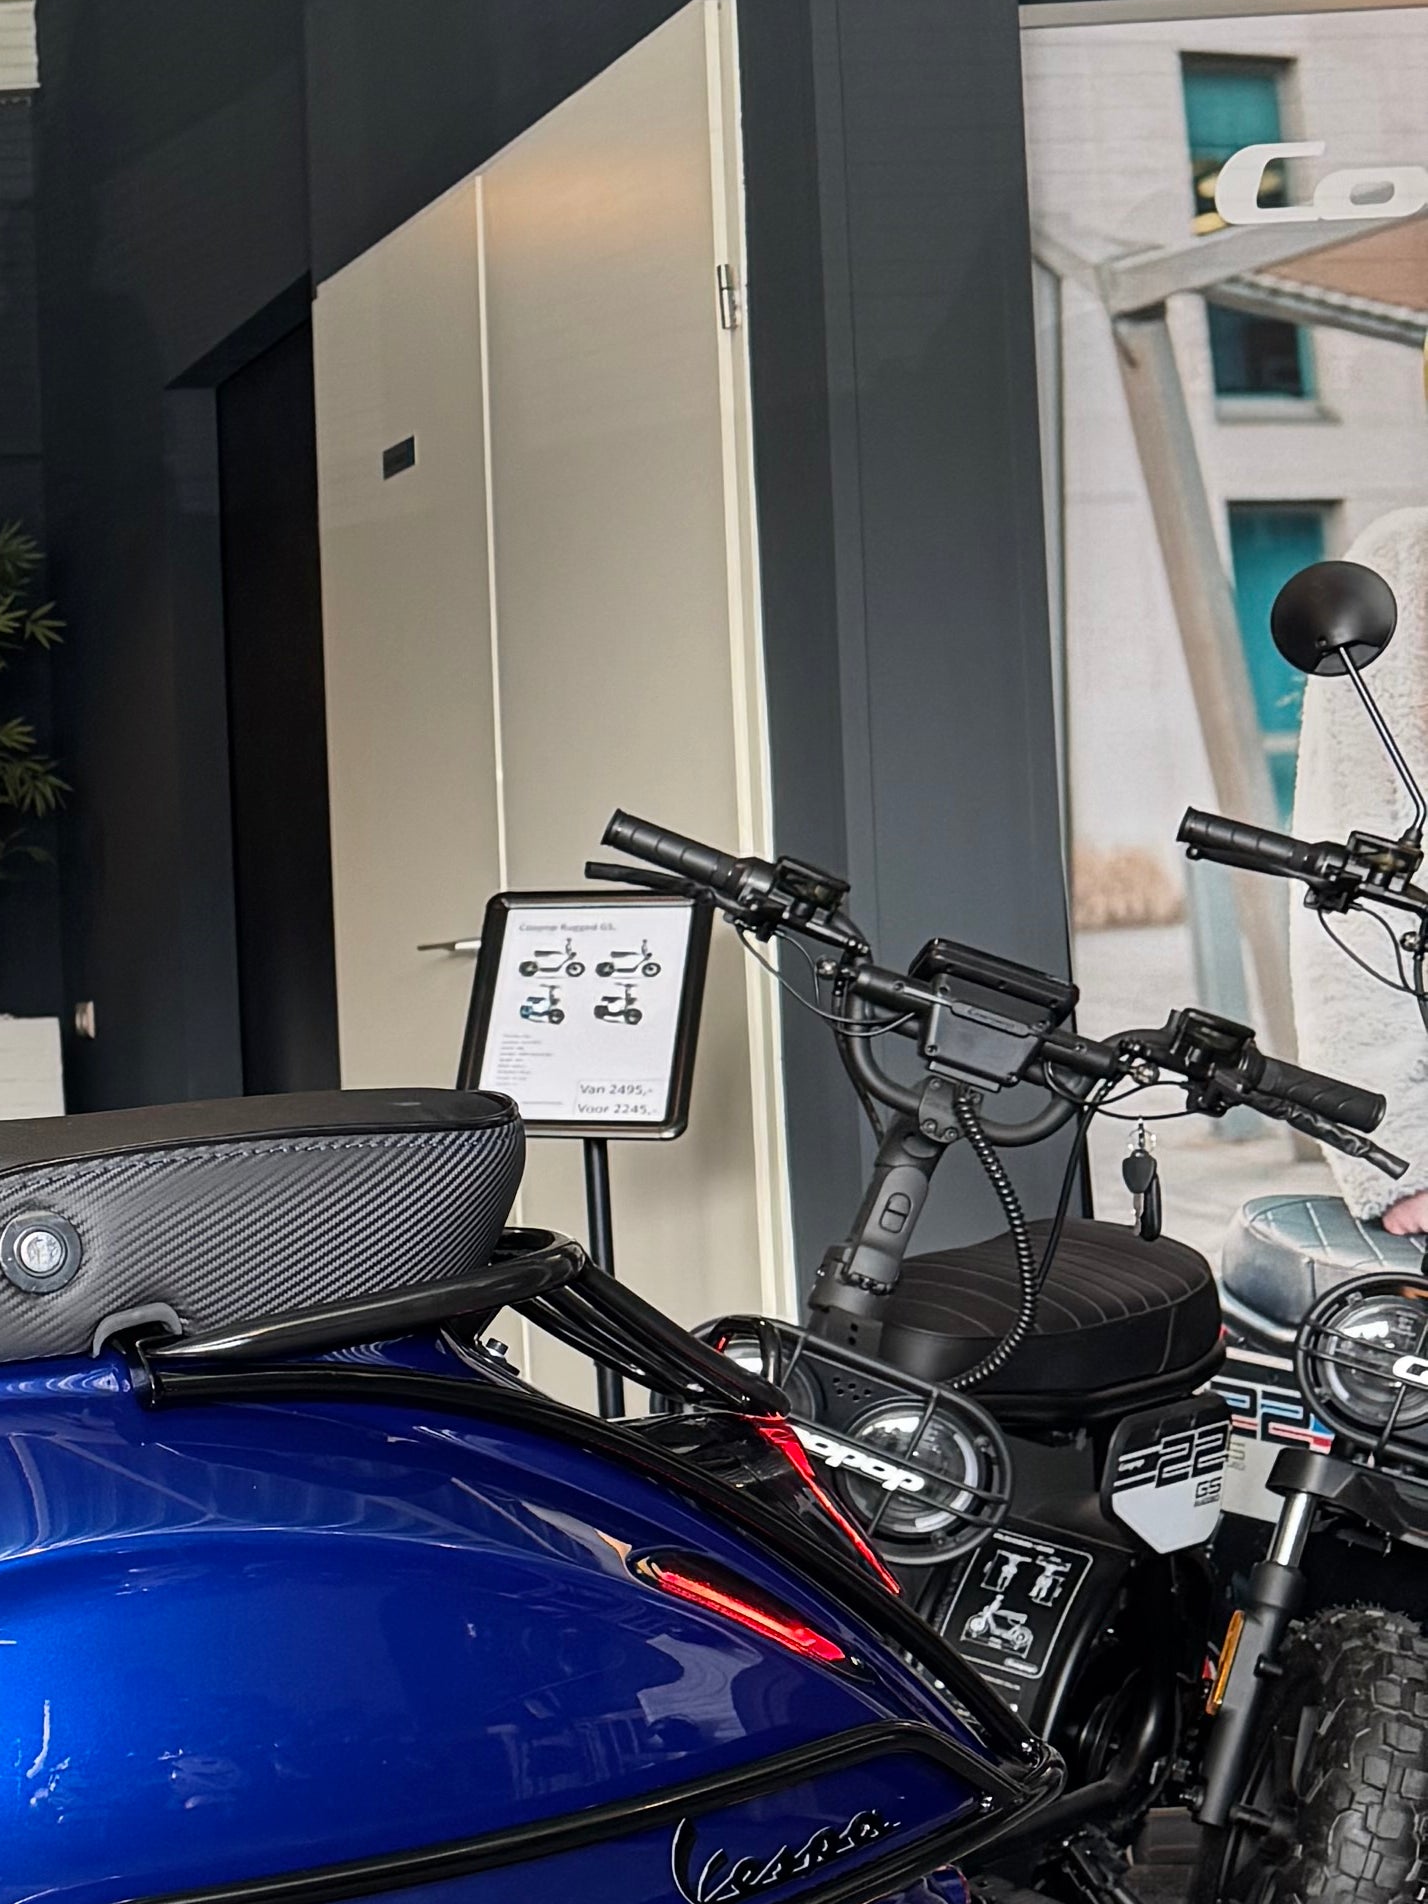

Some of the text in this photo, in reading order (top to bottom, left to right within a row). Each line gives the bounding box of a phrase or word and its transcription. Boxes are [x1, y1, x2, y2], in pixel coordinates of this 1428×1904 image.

[580, 1084, 605, 1095] Van
[577, 1104, 609, 1114] Voor
[1194, 1475, 1224, 1499] GS
